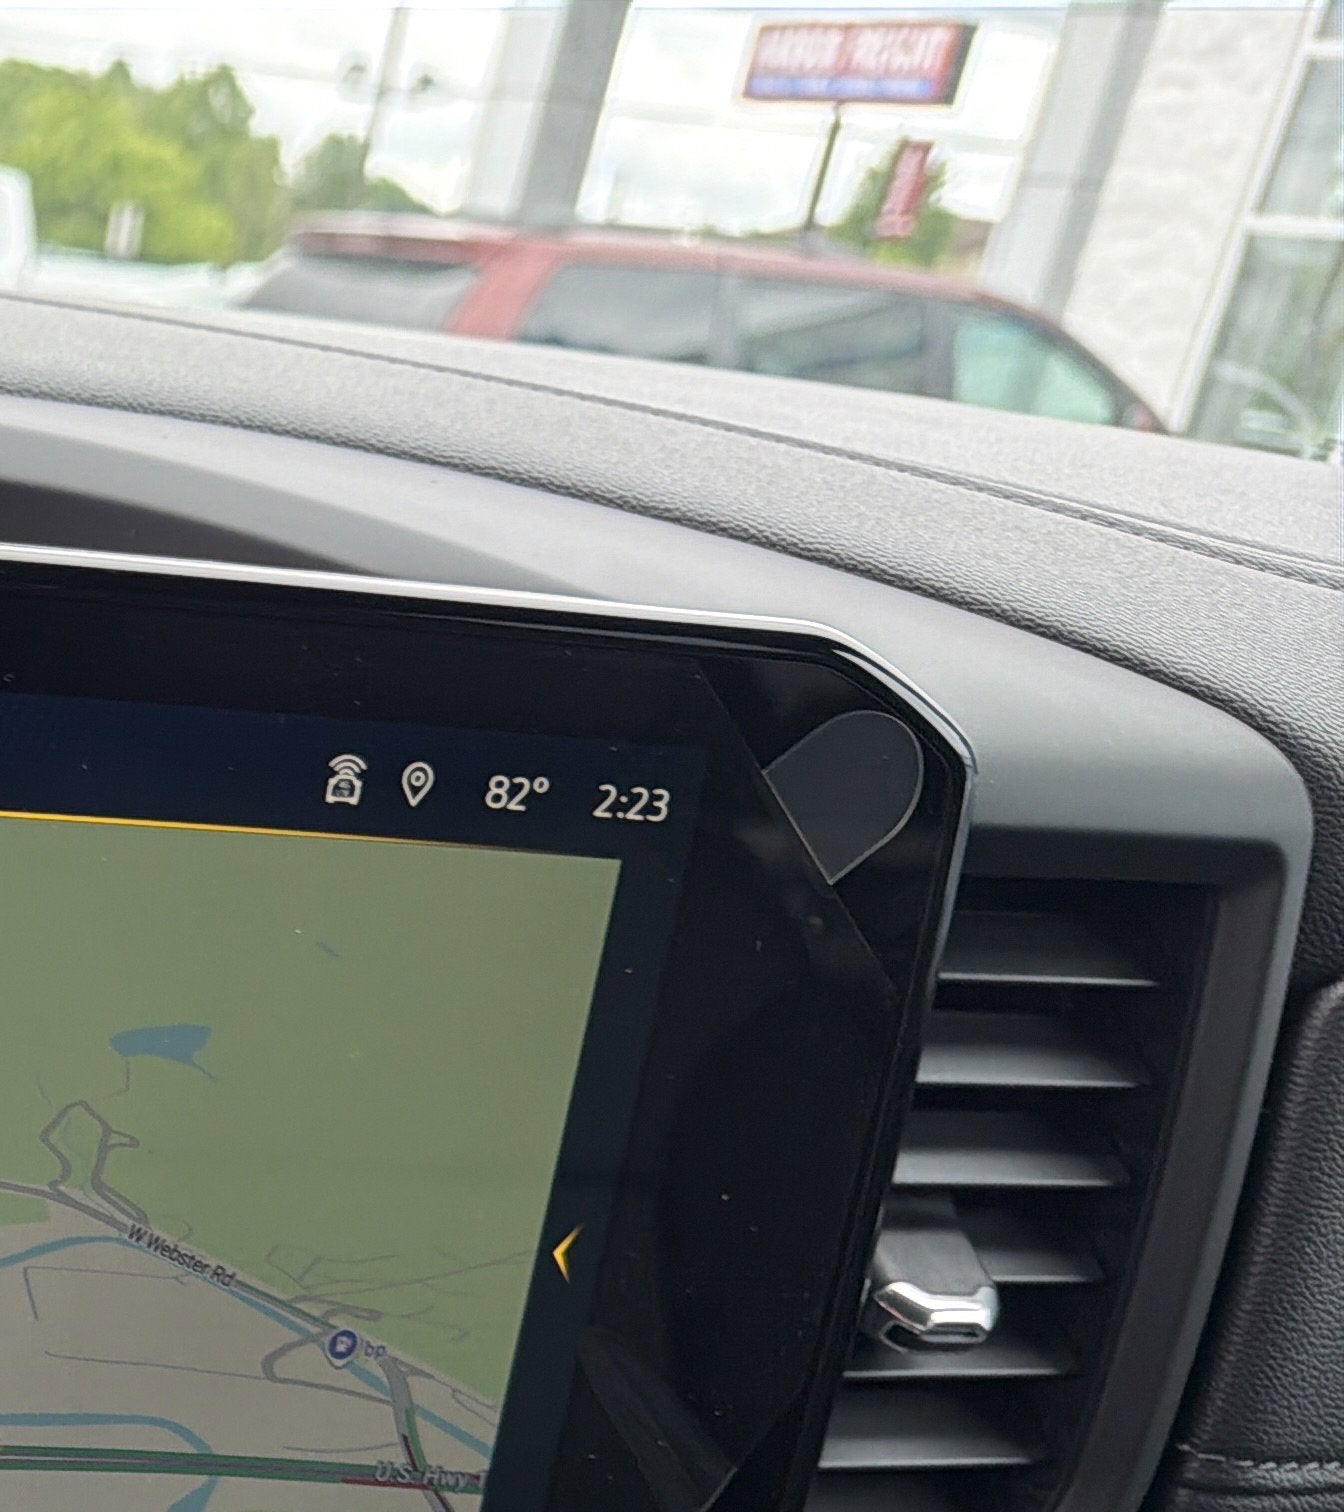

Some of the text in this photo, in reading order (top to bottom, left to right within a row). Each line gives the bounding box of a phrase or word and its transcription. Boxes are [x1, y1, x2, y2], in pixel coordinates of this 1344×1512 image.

[484, 775, 551, 812] 82°
[592, 784, 672, 822] 2:23
[128, 1223, 236, 1288] W Webster Rd
[364, 1341, 387, 1360] bp
